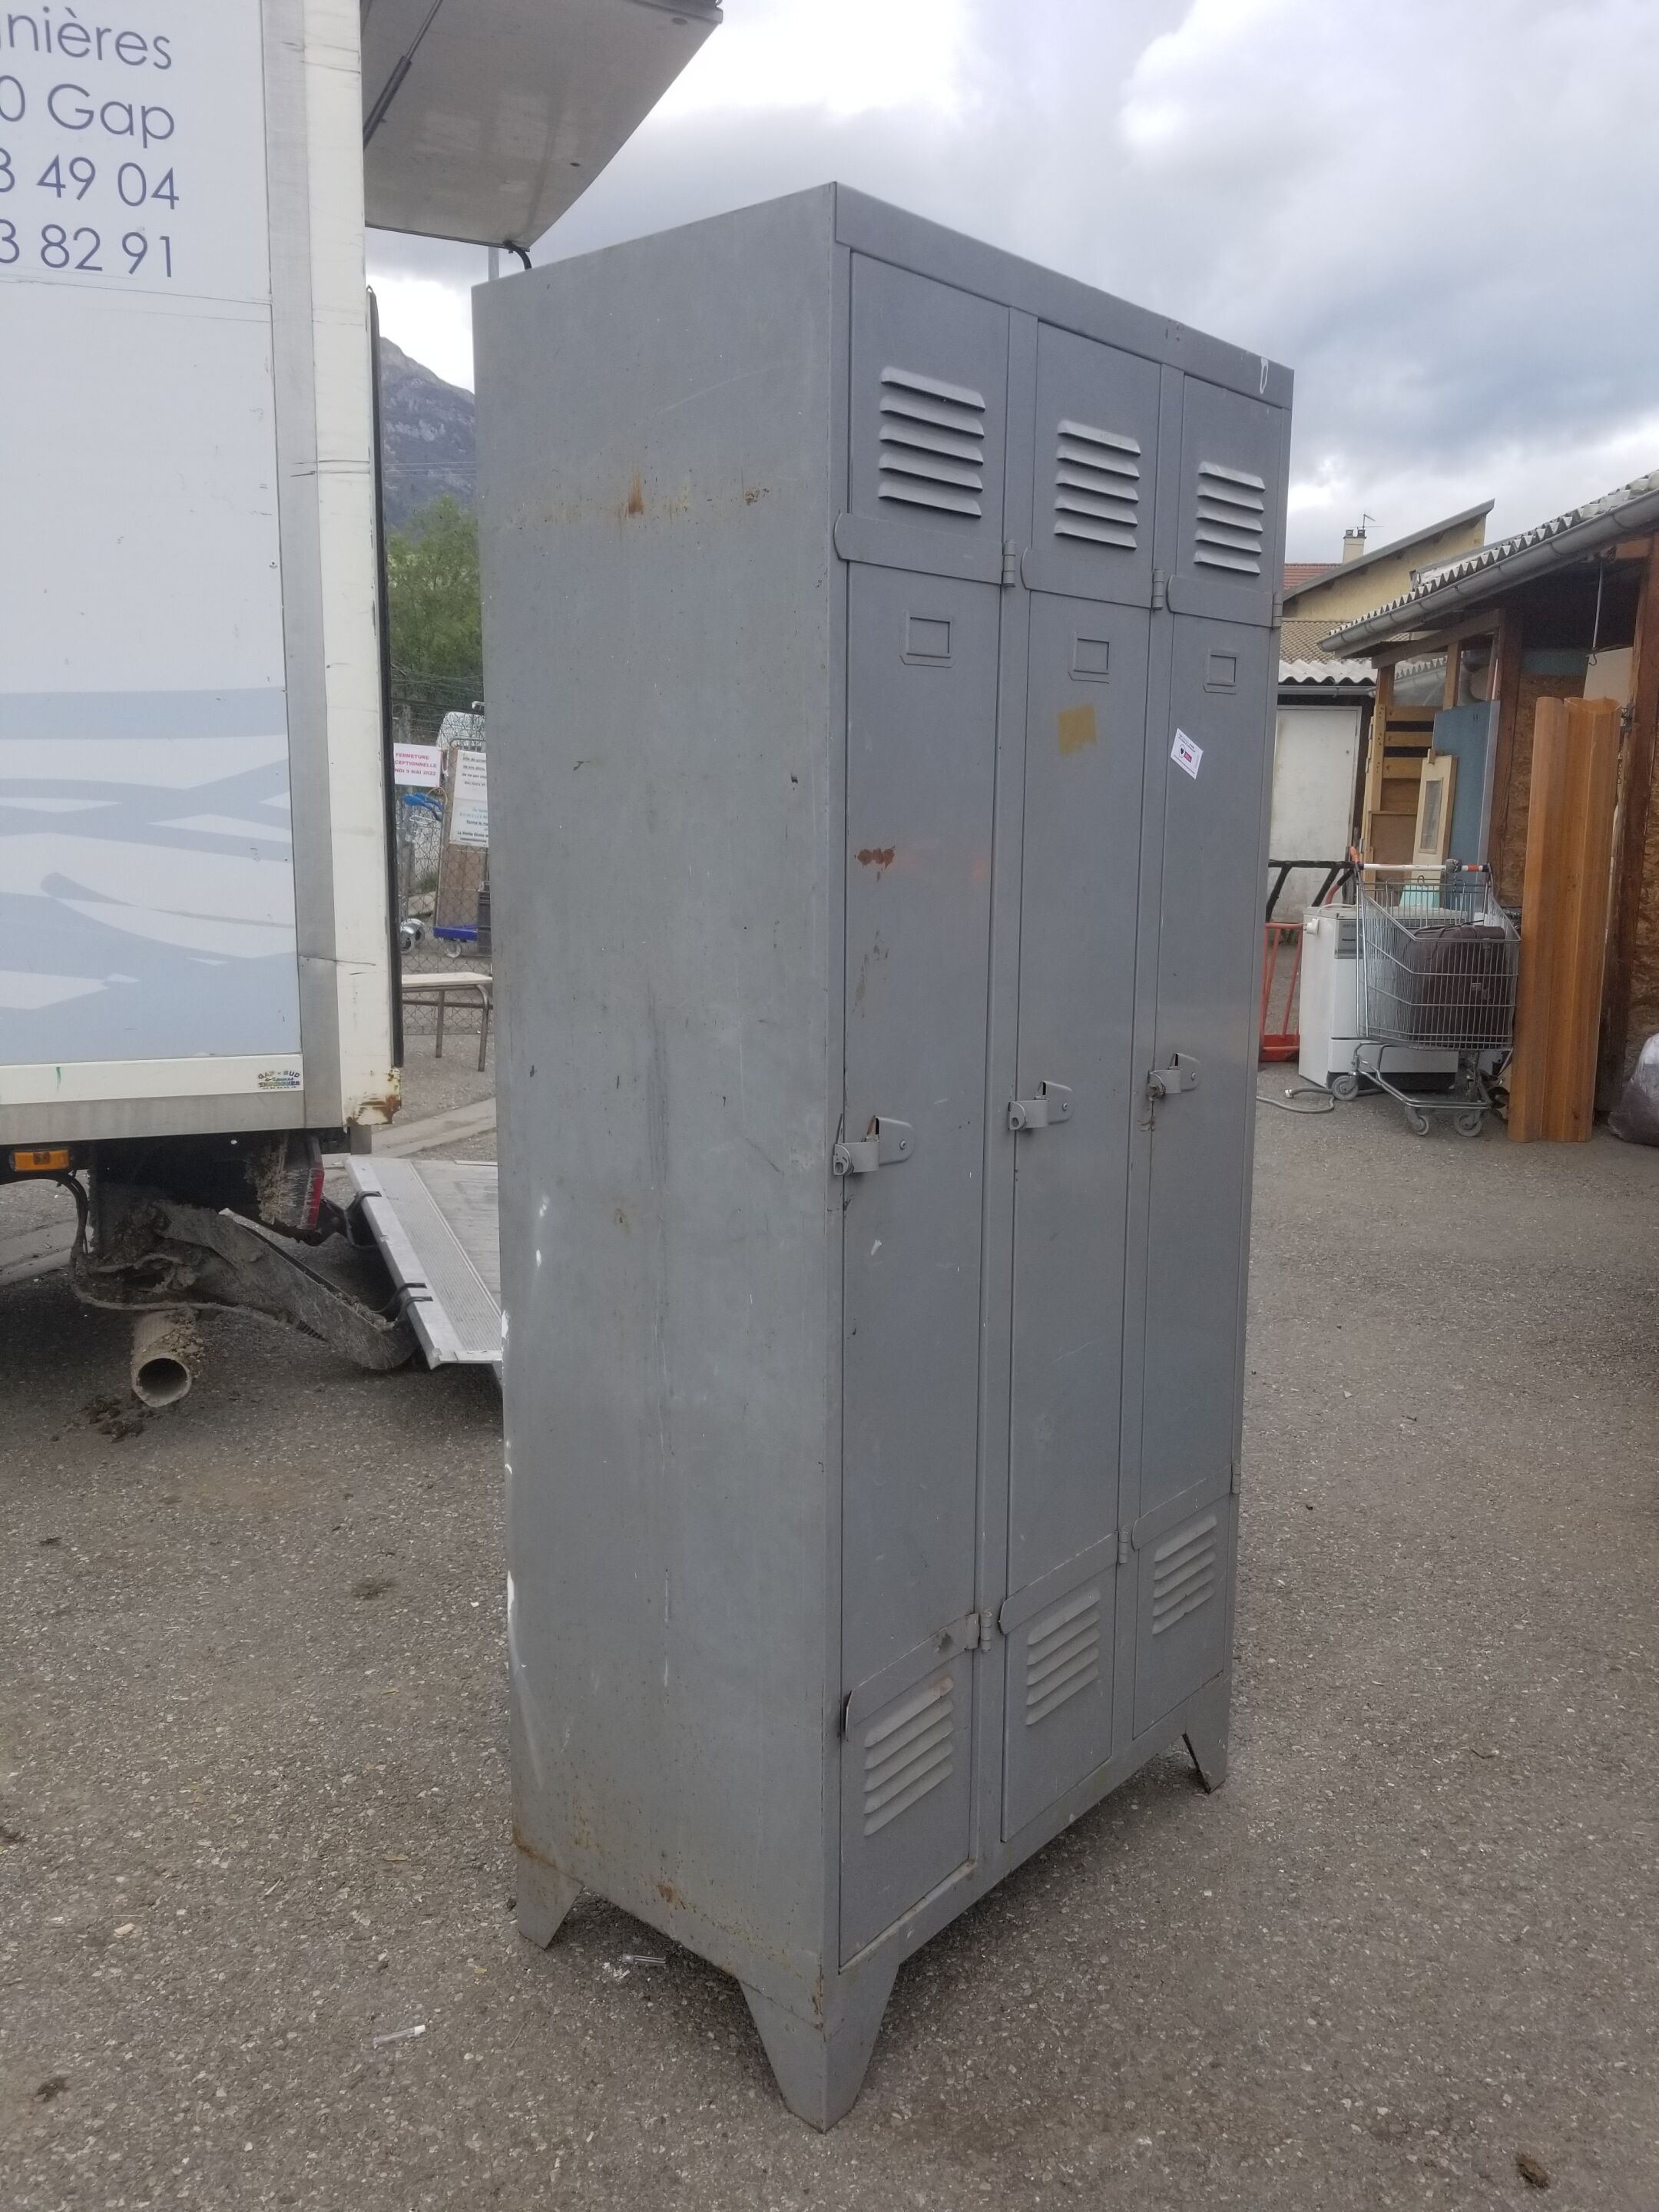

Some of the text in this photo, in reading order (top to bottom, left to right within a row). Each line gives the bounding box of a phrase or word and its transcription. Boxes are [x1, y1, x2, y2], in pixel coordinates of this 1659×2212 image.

[0, 6, 172, 70] nières
[48, 83, 174, 149] Gap
[36, 154, 96, 200] 49
[118, 162, 180, 210] 04
[0, 219, 172, 277] 3 82 91
